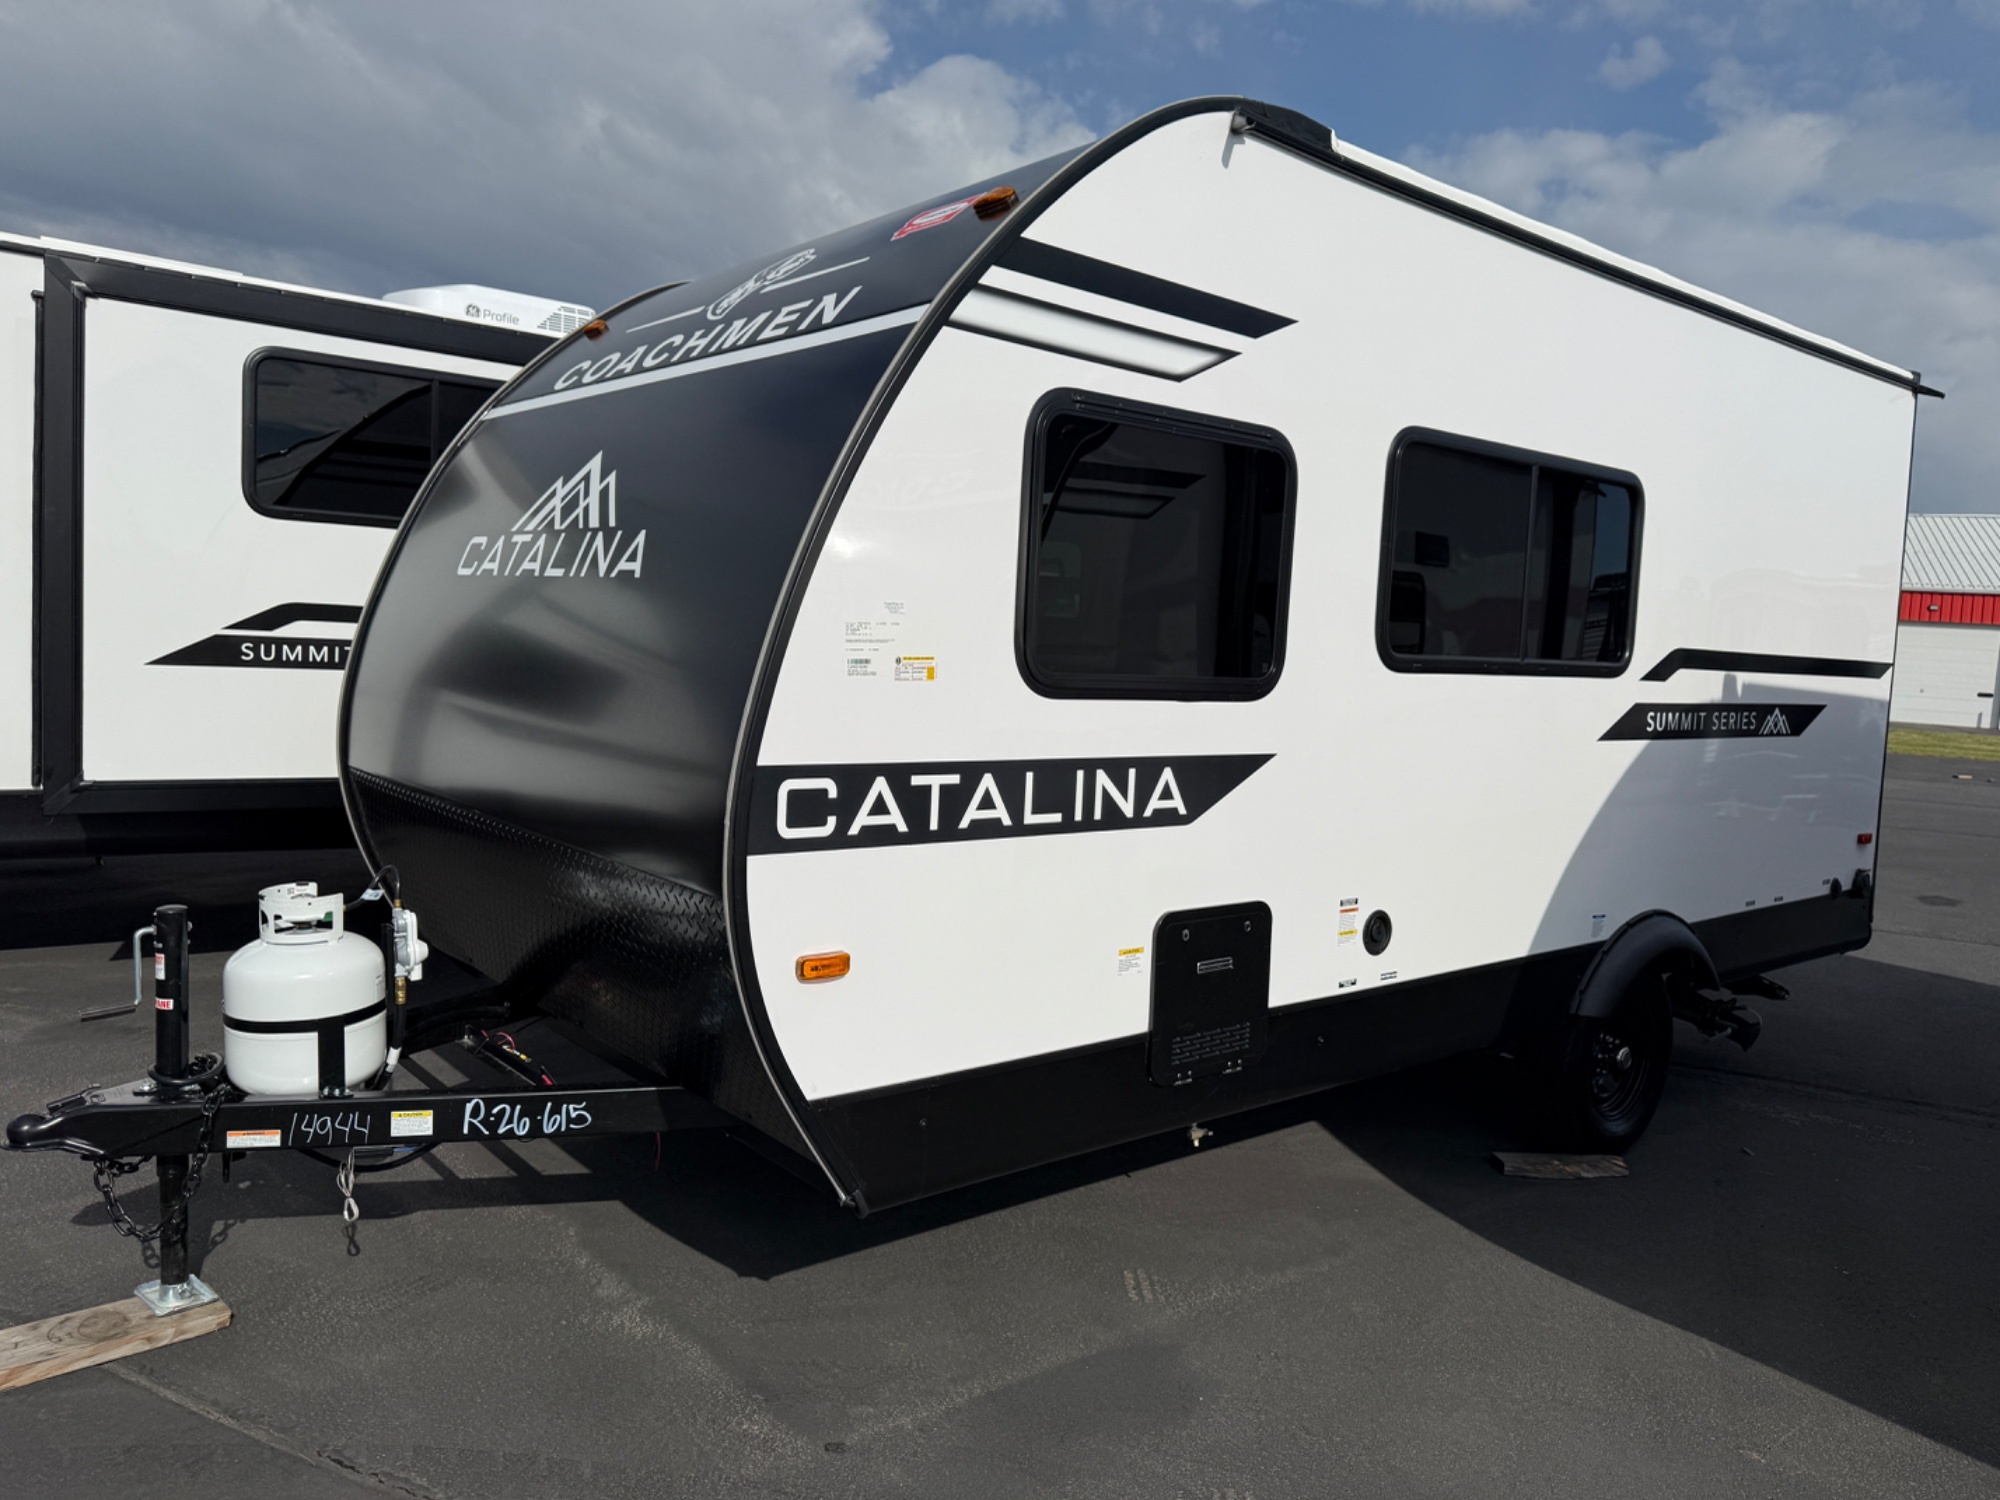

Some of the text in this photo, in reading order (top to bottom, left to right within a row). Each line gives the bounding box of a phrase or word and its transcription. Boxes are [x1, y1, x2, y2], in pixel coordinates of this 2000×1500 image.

[483, 308, 519, 325] Profile
[553, 285, 863, 390] COACHMEN
[457, 528, 647, 578] CATALINA
[1646, 711, 1757, 732] SUMMIT SERIES
[776, 766, 1188, 840] CATALINA
[288, 1111, 372, 1146] 14944
